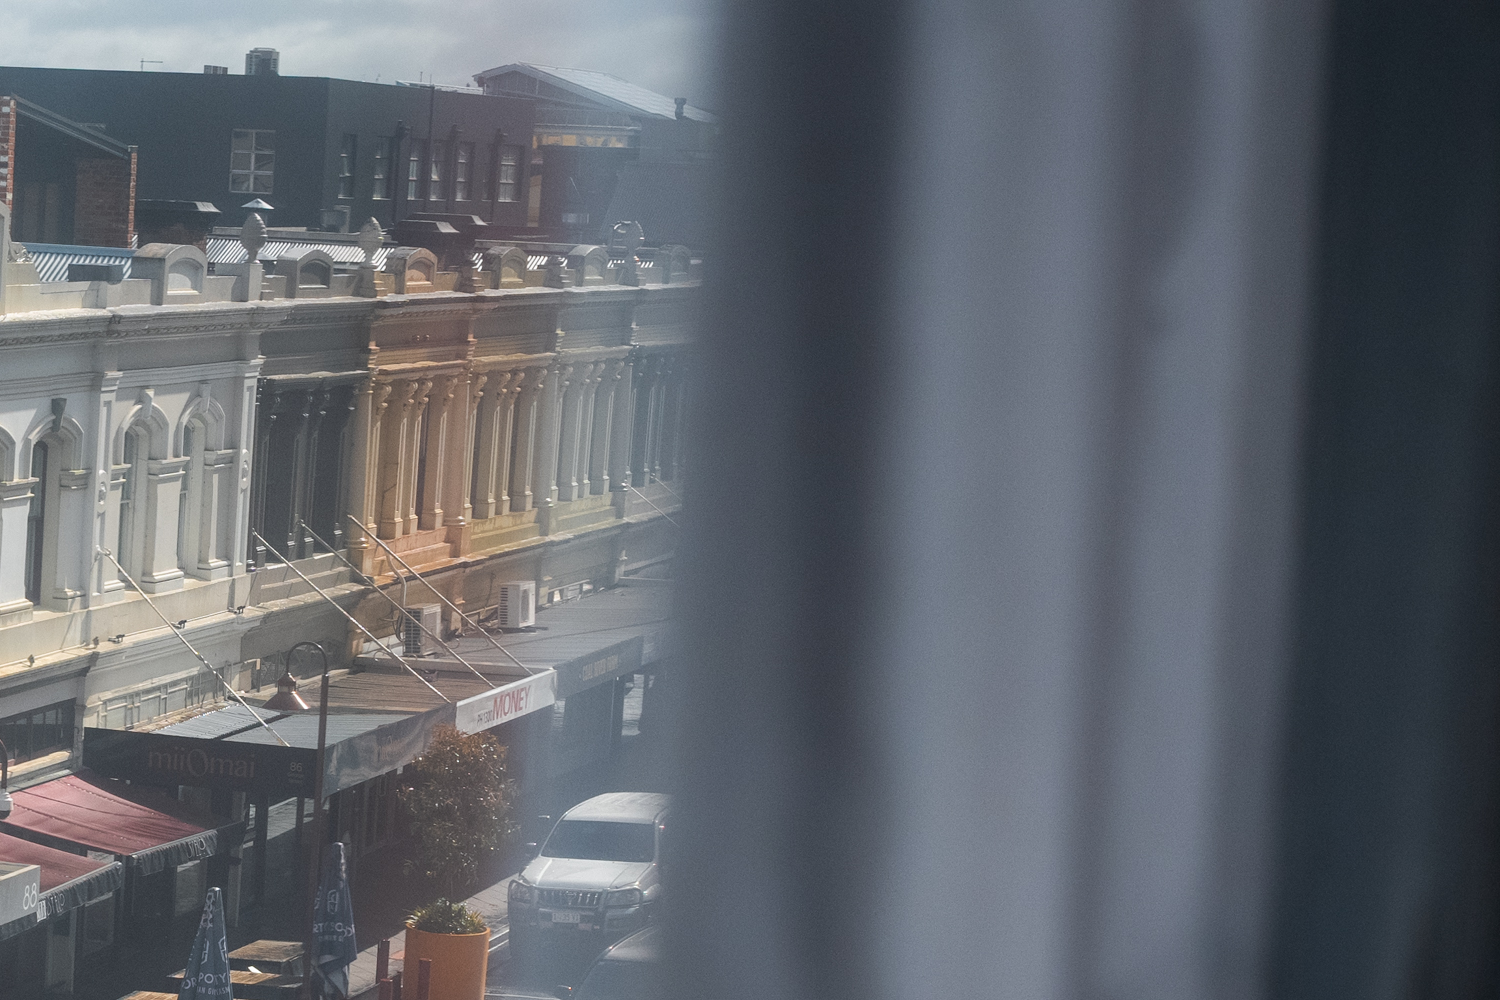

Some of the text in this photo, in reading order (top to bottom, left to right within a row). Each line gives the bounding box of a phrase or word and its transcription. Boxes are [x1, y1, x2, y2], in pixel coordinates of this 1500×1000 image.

[492, 685, 531, 720] MONEY
[289, 761, 303, 772] 86
[22, 882, 37, 911] 88
